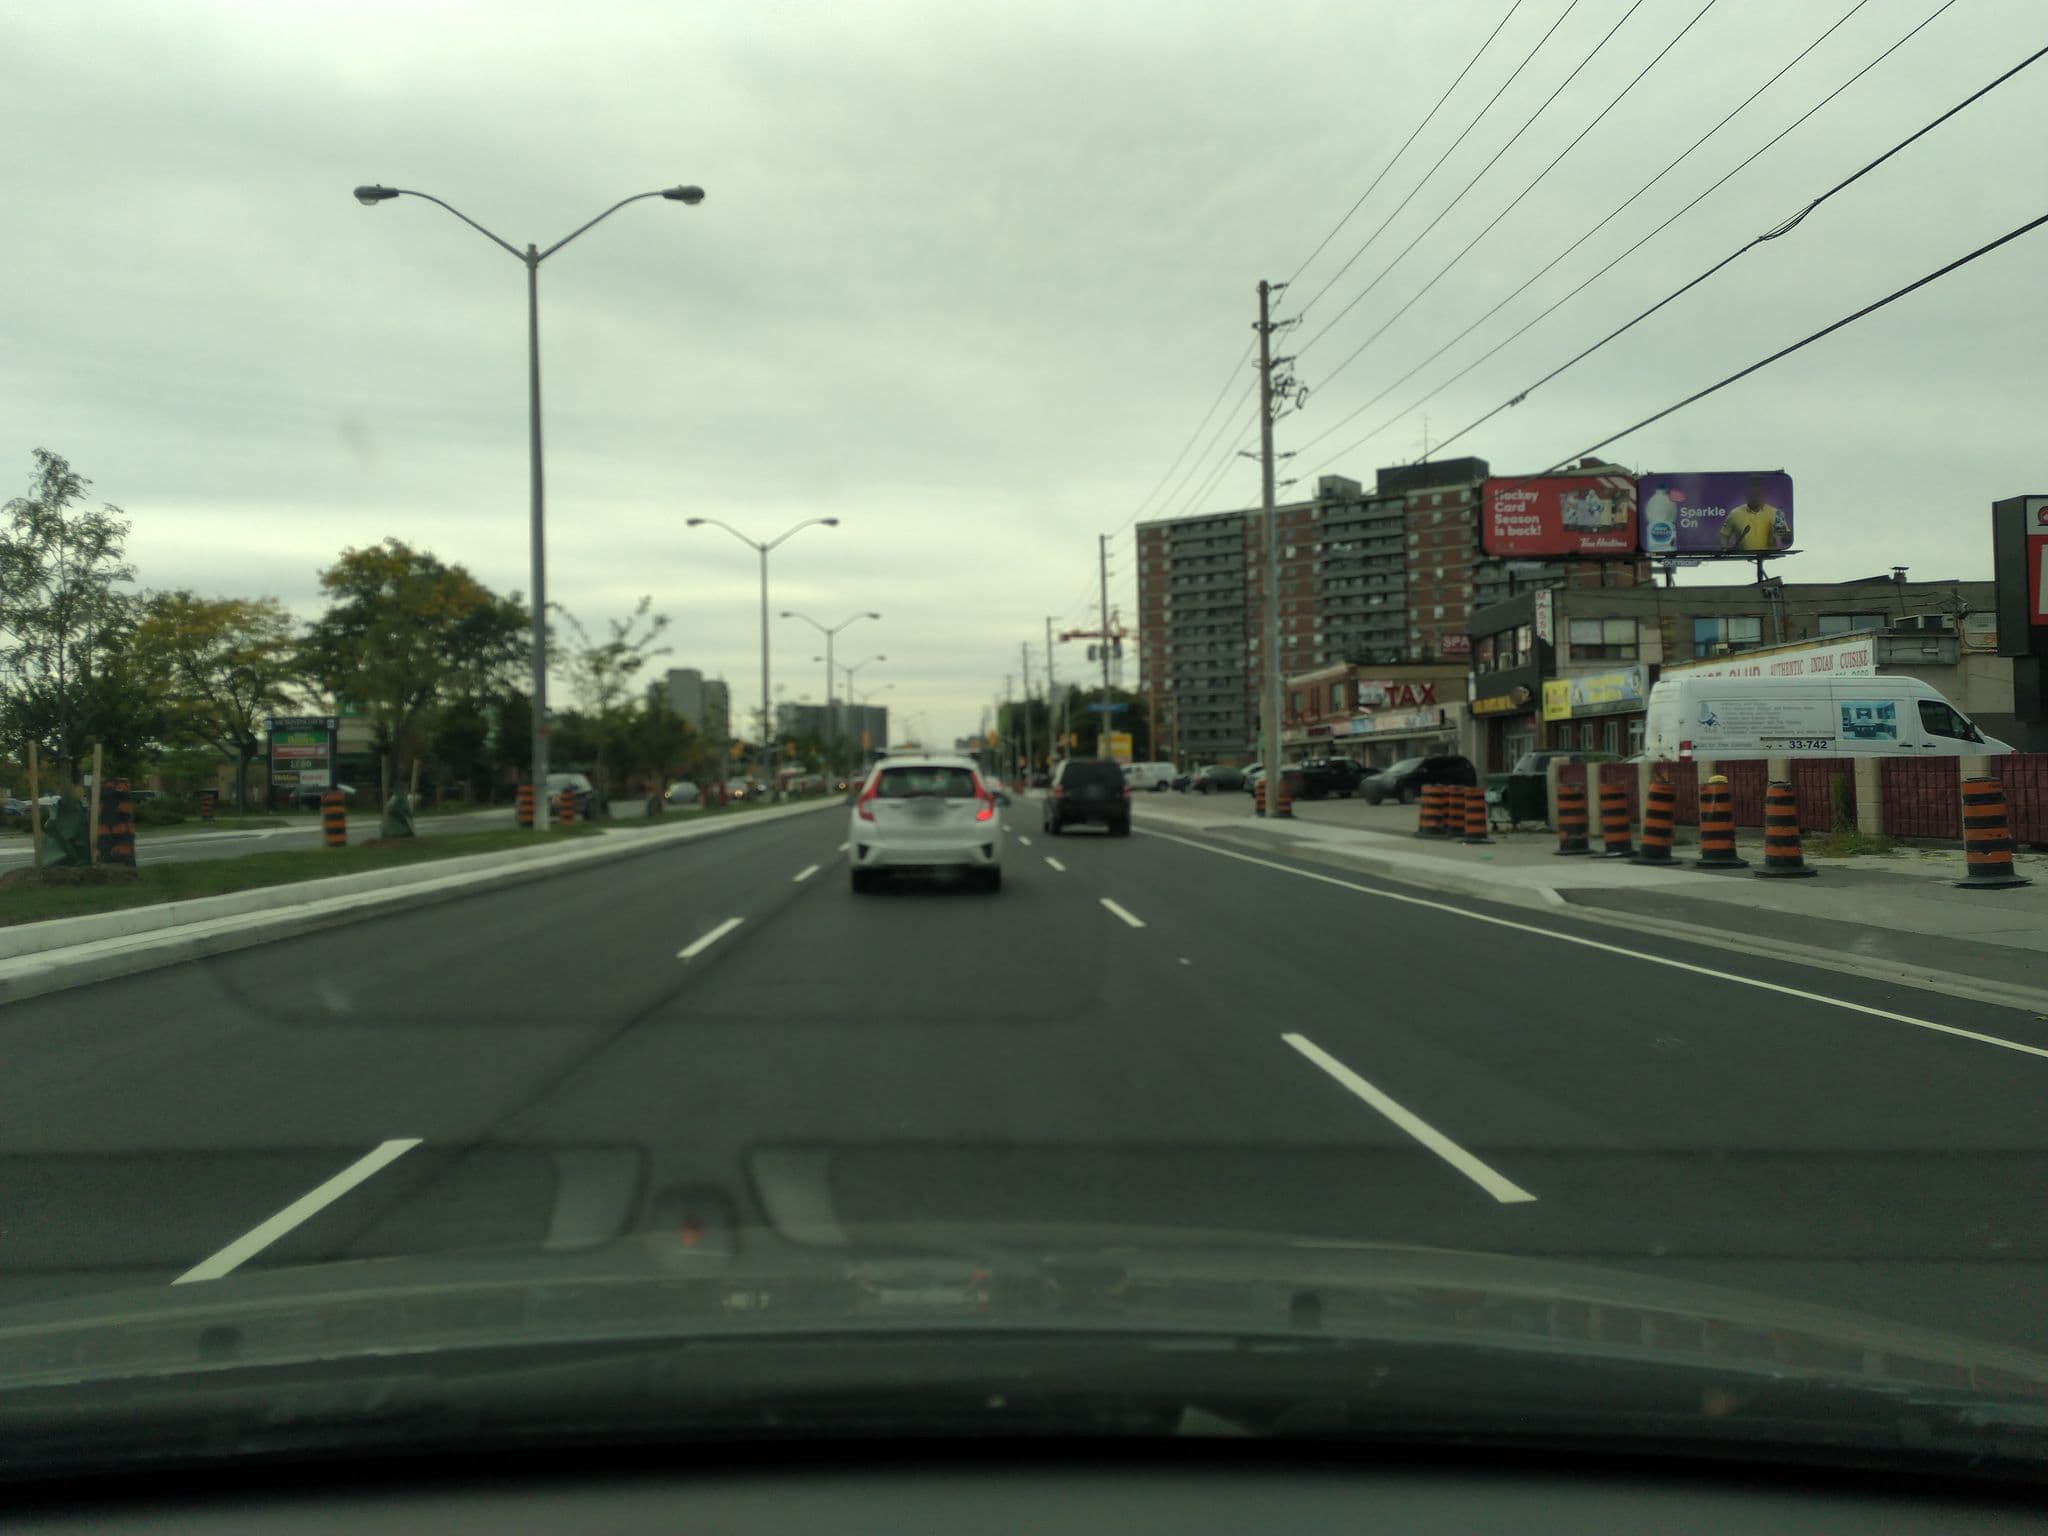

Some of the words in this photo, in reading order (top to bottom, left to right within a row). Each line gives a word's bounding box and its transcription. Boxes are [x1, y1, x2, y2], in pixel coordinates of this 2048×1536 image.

[1494, 502, 1526, 512] Card
[1680, 507, 1726, 518] Sparkle
[1494, 514, 1540, 524] Season
[1680, 518, 1698, 528] On
[1494, 525, 1505, 536] is
[1507, 525, 1541, 536] back!
[1810, 654, 1834, 673] INDIAN
[1840, 649, 1868, 669] CUISINE
[1385, 682, 1437, 705] TAX
[1789, 740, 1827, 749] 33-742
